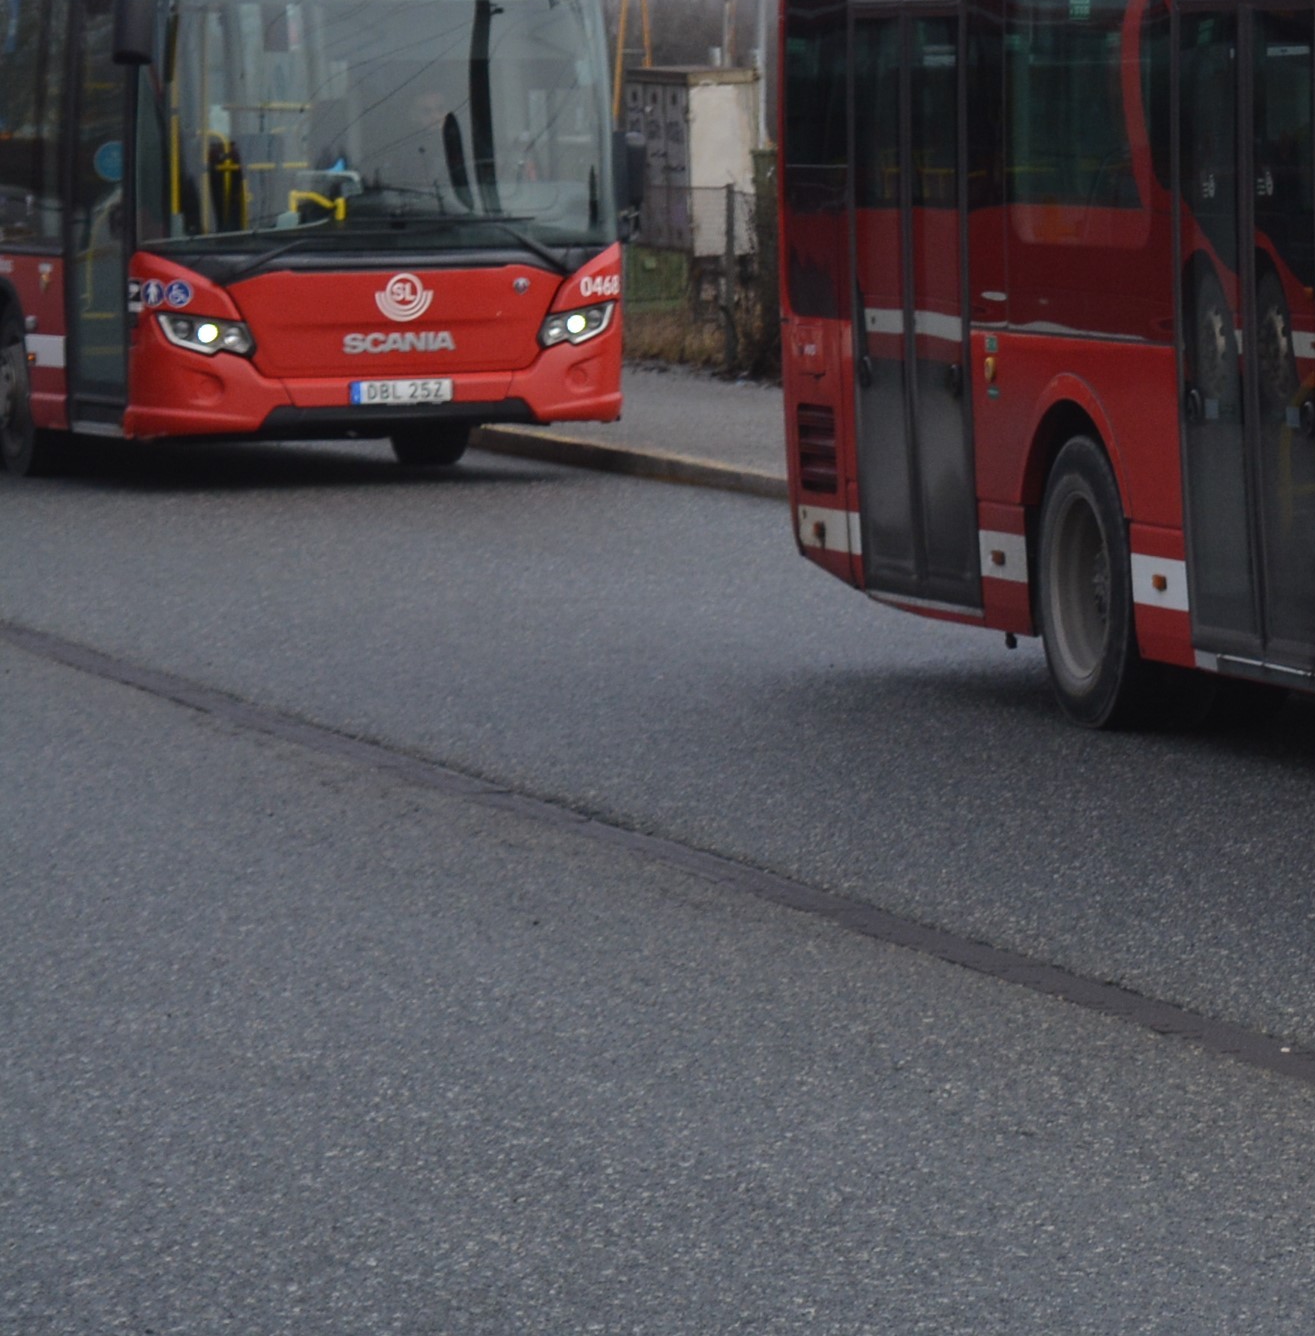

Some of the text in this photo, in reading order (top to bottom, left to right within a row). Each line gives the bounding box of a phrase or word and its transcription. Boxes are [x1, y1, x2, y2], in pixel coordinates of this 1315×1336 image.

[391, 282, 414, 301] SL
[343, 331, 456, 354] SCANIA
[367, 383, 399, 401] DBL
